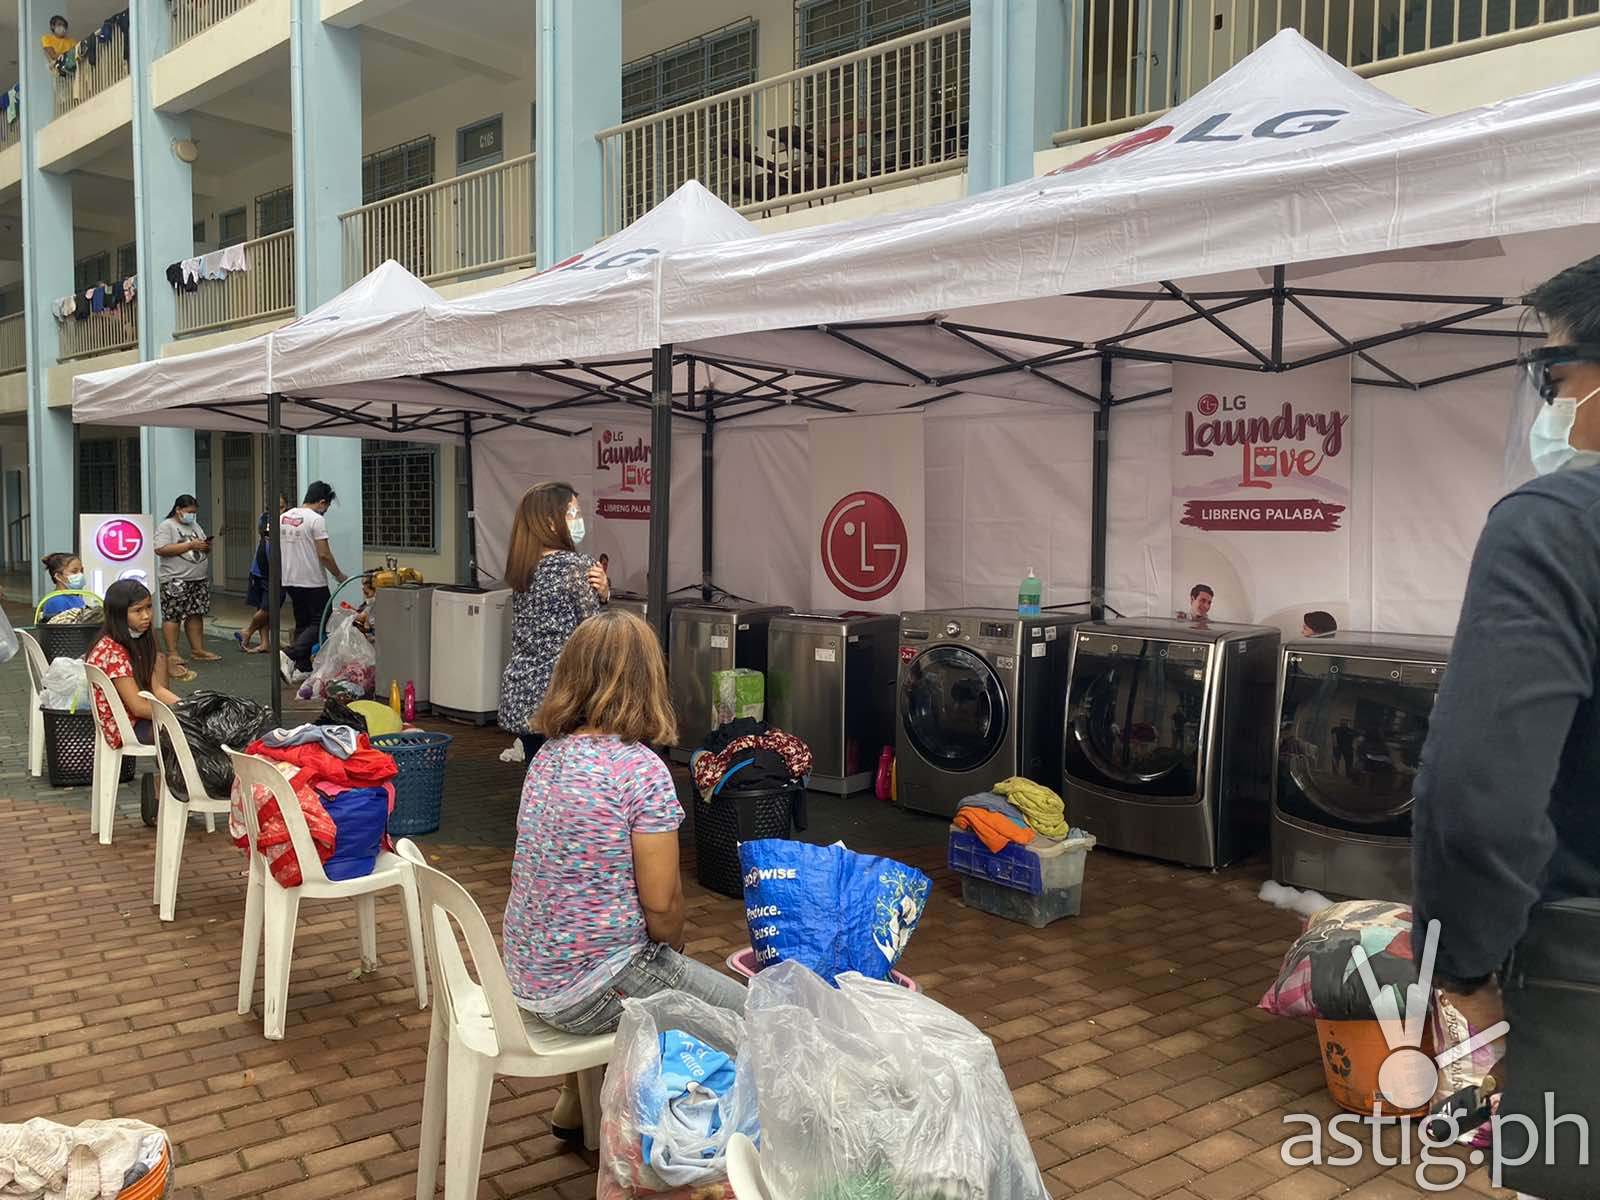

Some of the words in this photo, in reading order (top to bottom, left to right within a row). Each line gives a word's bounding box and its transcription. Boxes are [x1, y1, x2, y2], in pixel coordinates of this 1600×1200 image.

[1176, 109, 1350, 143] LG
[1223, 395, 1246, 411] LG
[613, 432, 623, 441] LG
[1182, 402, 1350, 457] Laundry
[597, 438, 651, 470] Laundr
[1238, 440, 1325, 489] Love
[1202, 508, 1261, 520] LIBRENG
[1266, 508, 1324, 520] PALABA
[752, 925, 779, 940] euse.
